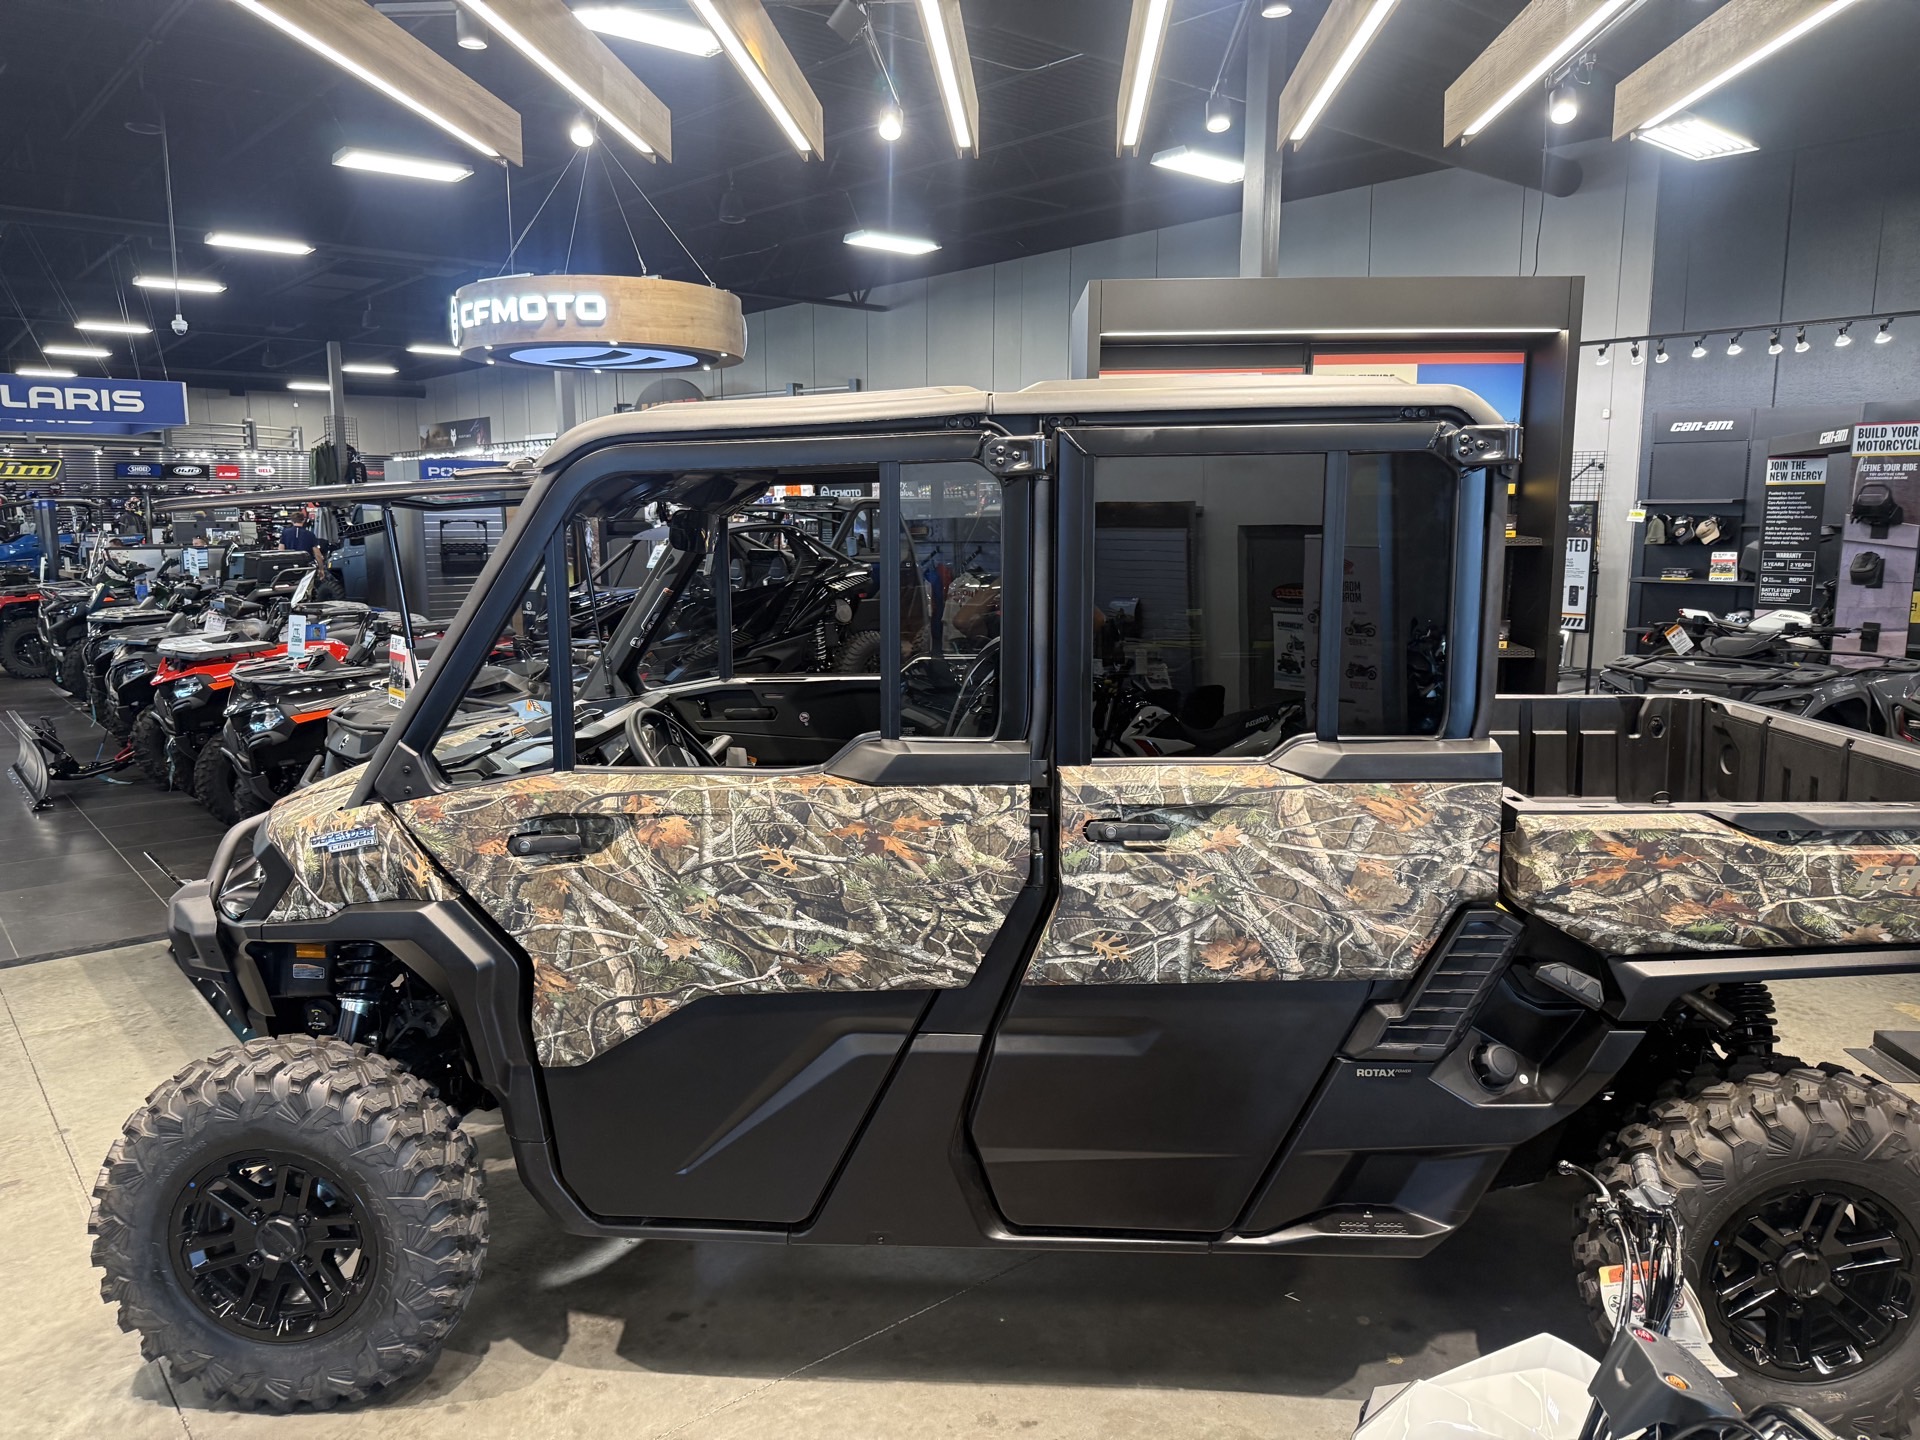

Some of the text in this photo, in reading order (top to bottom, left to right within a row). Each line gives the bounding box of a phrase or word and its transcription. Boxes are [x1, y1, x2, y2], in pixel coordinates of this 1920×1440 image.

[460, 294, 607, 329] CFMOTO
[1858, 426, 1919, 439] BUILD YOUR
[1770, 461, 1807, 470] JOIN THE
[1883, 463, 1900, 471] YOUR
[1902, 463, 1918, 471] RIDE
[1770, 470, 1823, 481] NEW ENERGY
[830, 489, 861, 497] CFMOTO
[1567, 539, 1588, 552] TED
[1356, 1068, 1396, 1078] ROTAX
